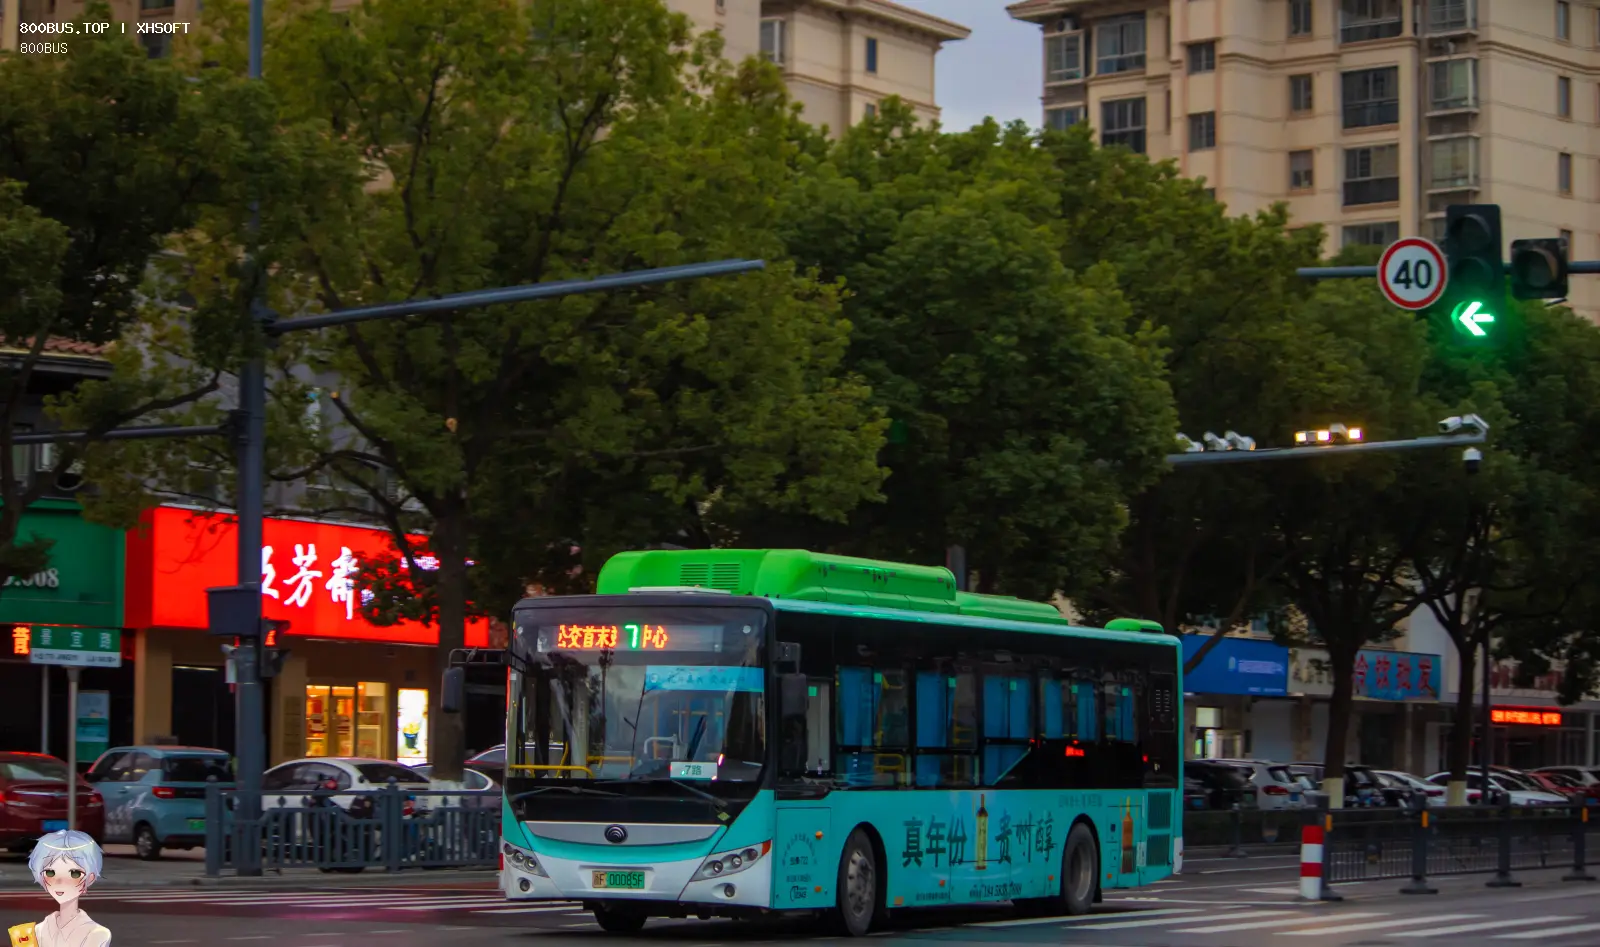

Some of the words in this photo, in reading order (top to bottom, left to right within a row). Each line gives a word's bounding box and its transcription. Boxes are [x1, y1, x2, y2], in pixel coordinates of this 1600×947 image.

[1392, 259, 1432, 290] 40
[624, 624, 639, 649] 7
[684, 764, 702, 776] 7路
[902, 813, 967, 868] 真年份
[995, 809, 1058, 864] 贵州醇
